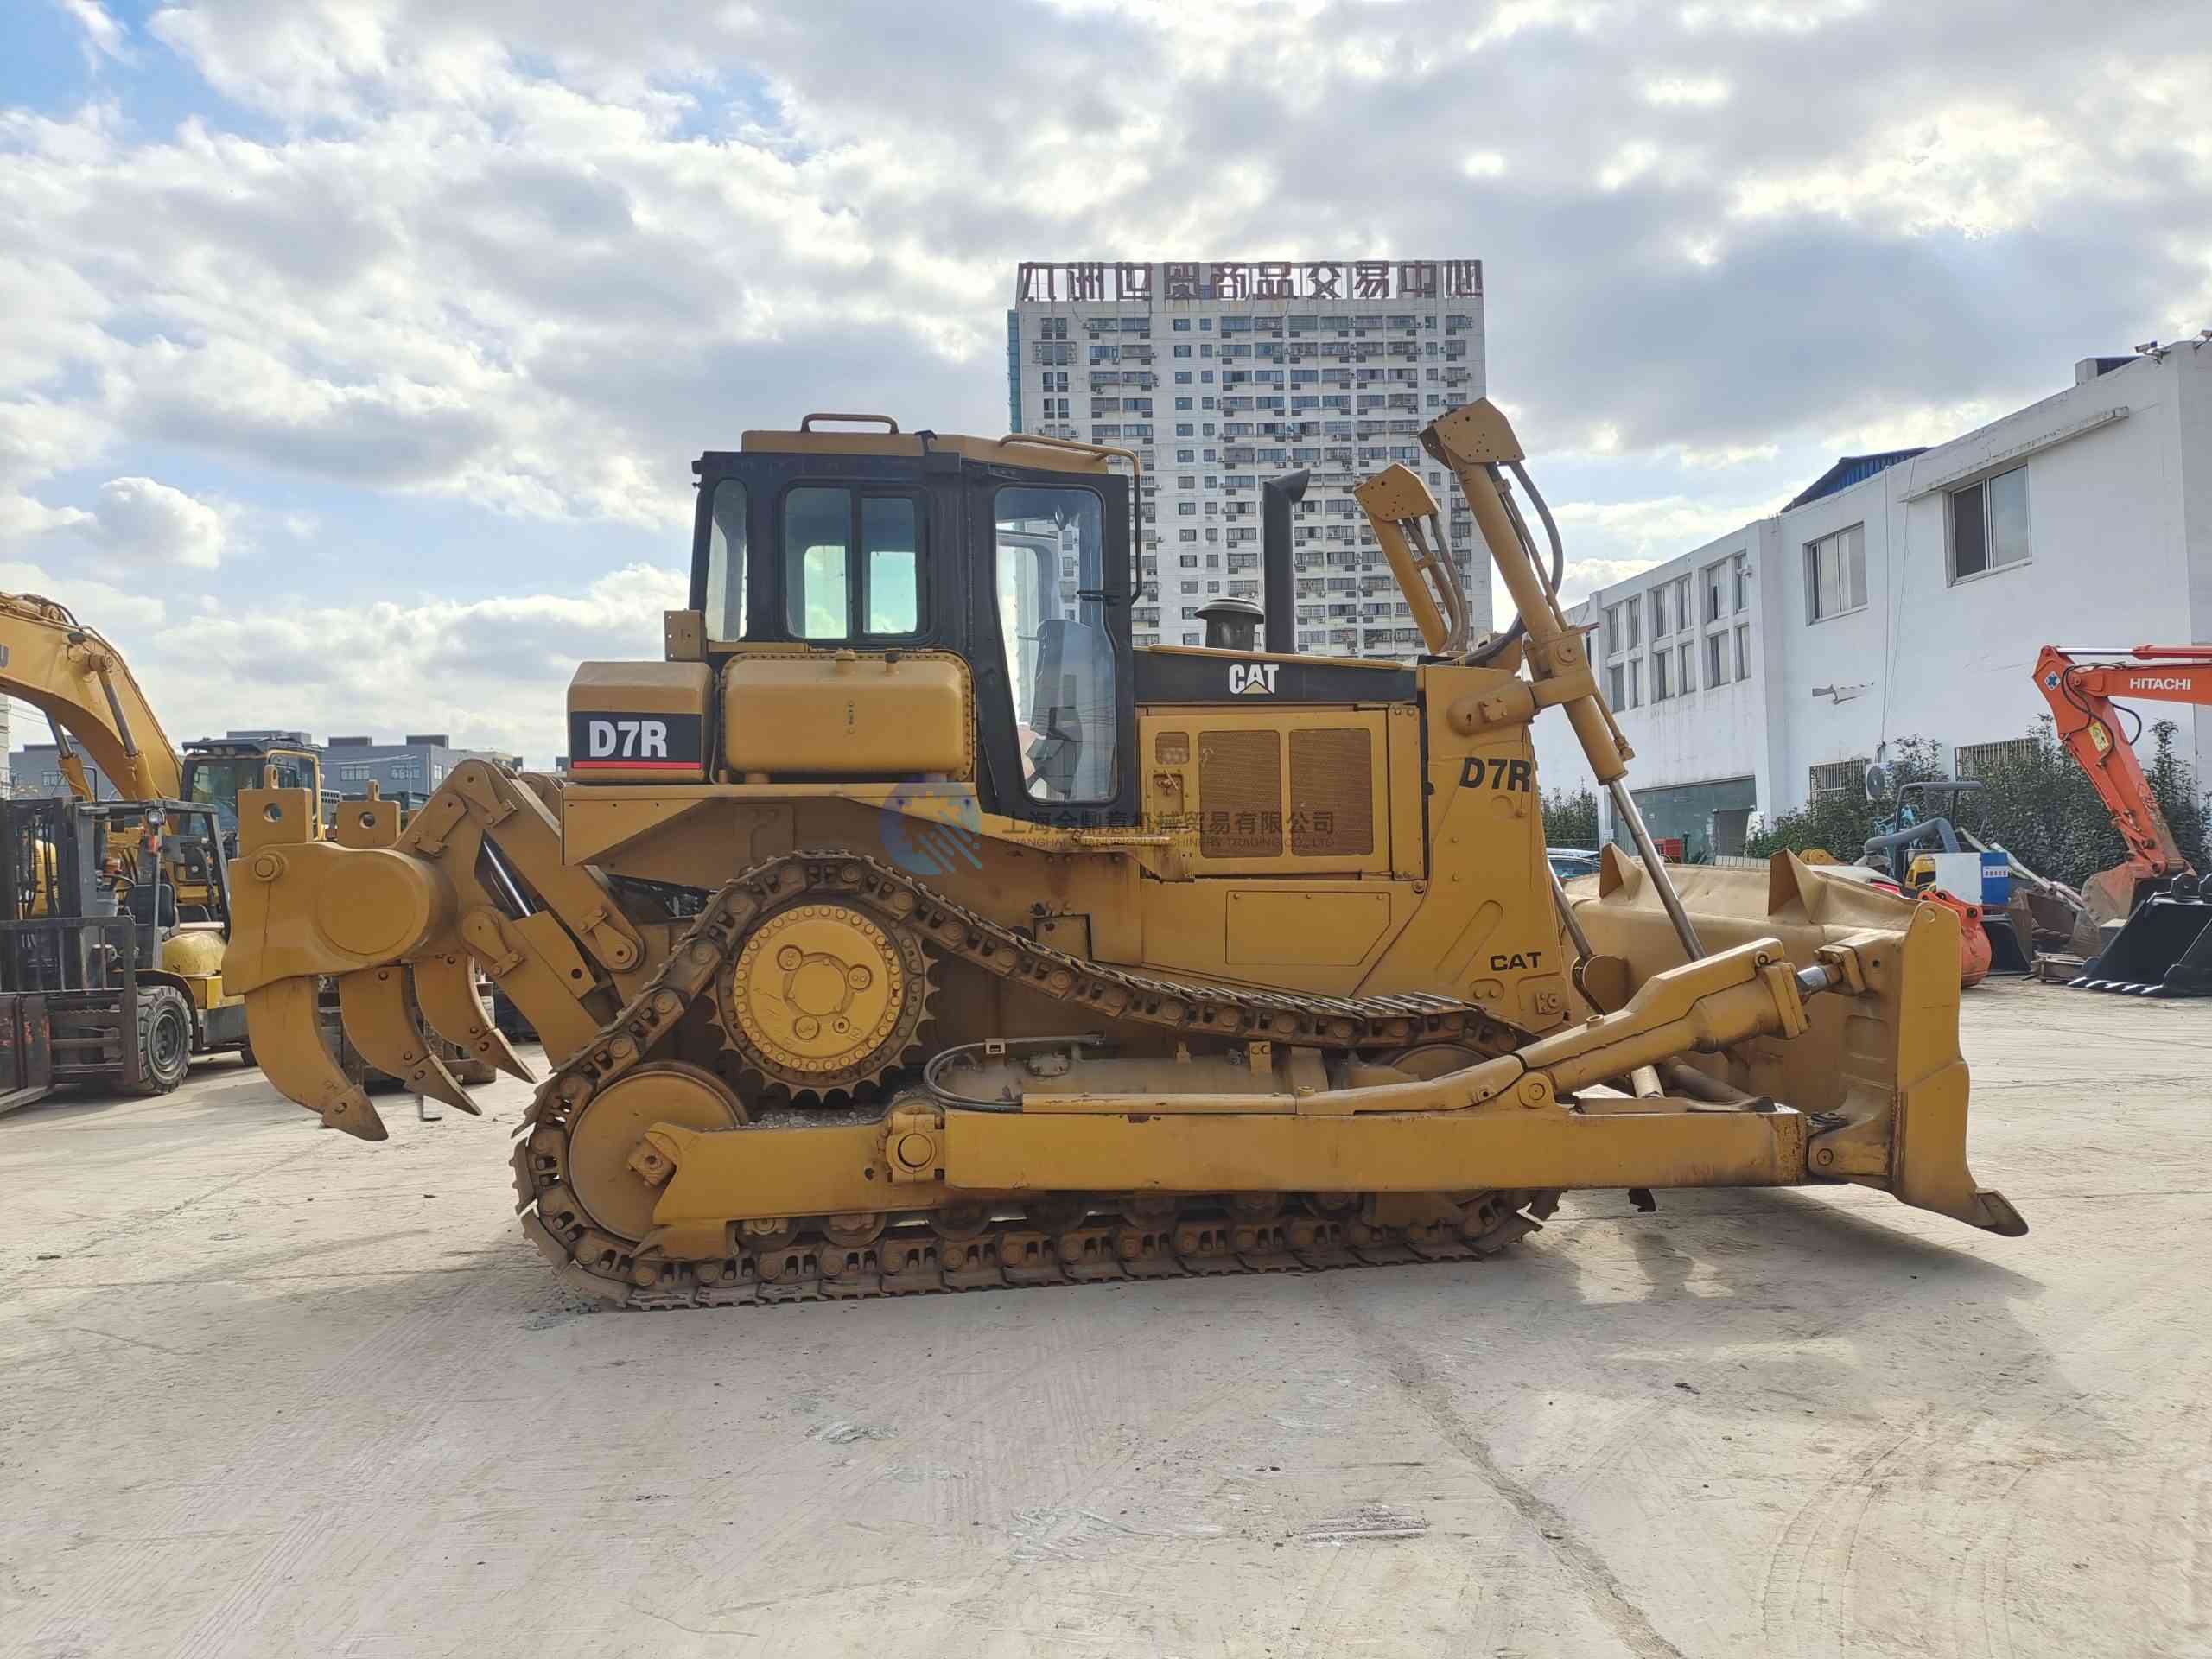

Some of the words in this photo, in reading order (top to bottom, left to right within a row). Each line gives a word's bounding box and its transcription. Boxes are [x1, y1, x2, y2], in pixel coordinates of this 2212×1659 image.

[1229, 664, 1280, 695] CAT
[2129, 677, 2192, 690] HITACHI
[589, 720, 667, 758] D7R
[1459, 757, 1531, 792] D7R
[1491, 951, 1541, 971] CAT
